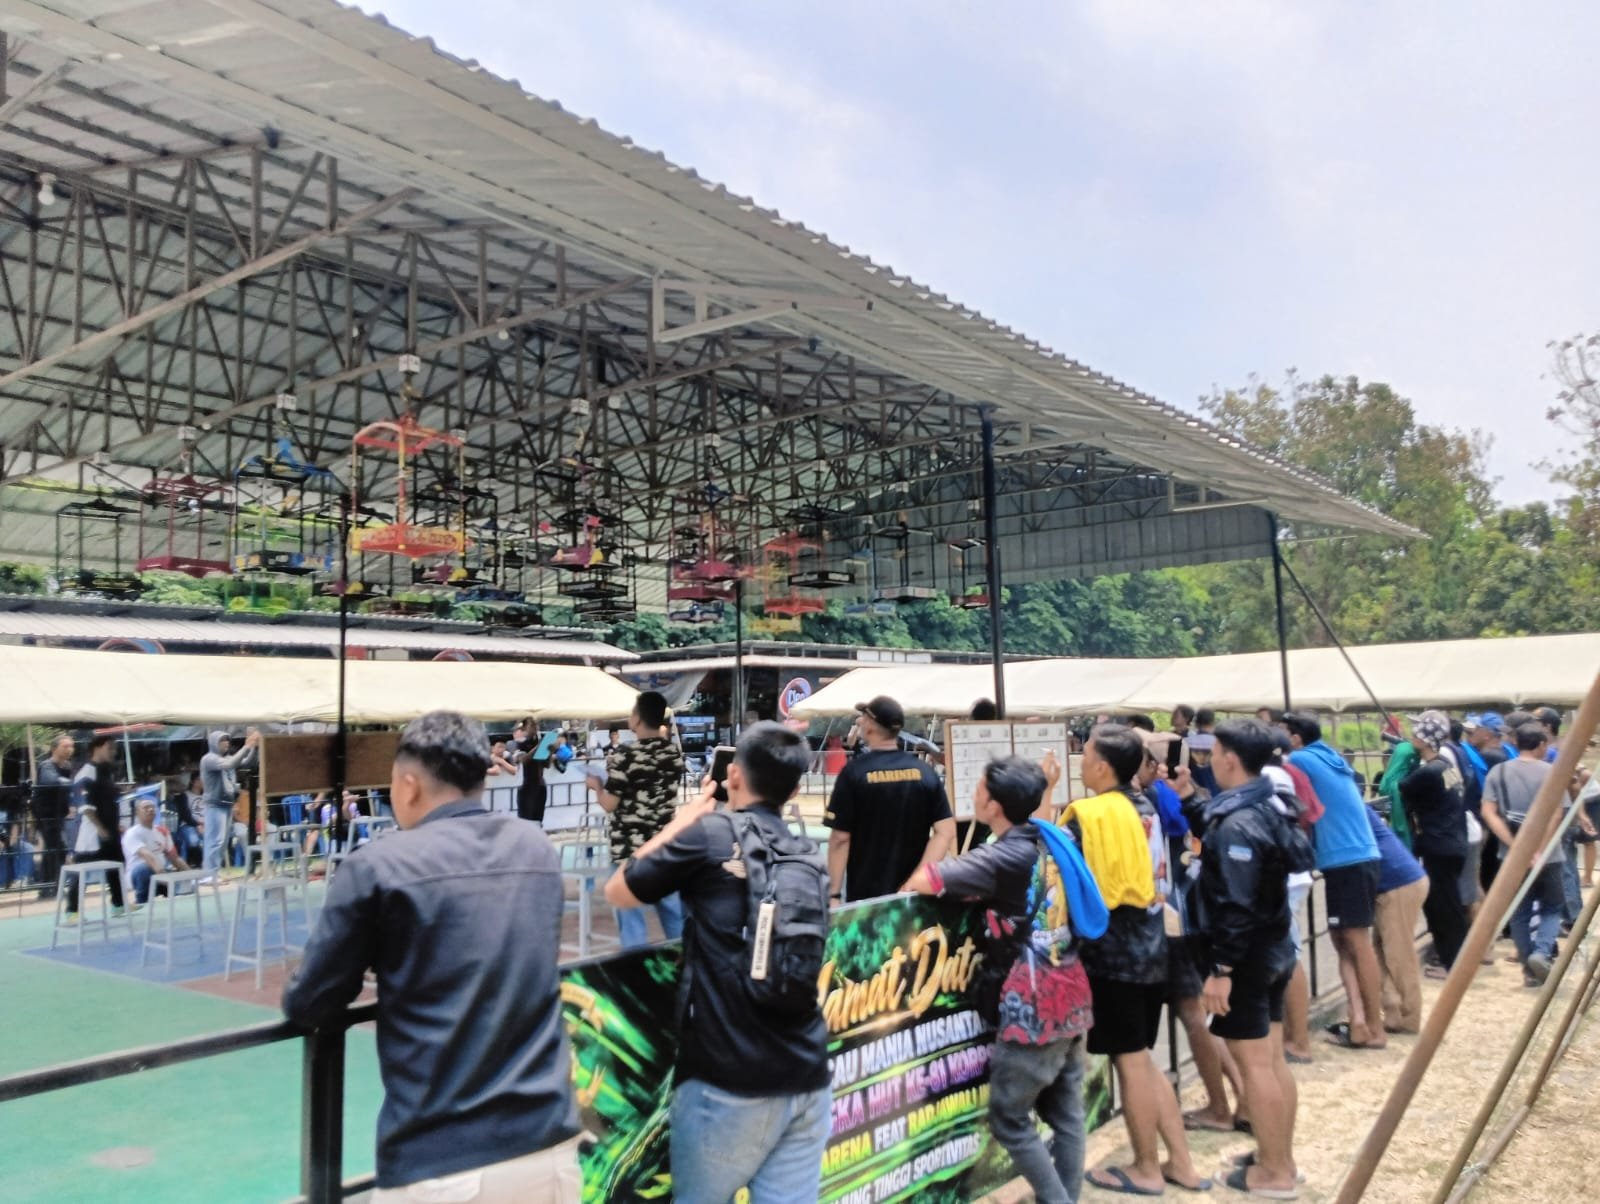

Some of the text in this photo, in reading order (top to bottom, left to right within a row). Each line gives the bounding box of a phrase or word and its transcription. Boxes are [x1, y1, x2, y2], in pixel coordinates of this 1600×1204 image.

[861, 1028, 914, 1077] MANIA
[868, 1076, 901, 1119] HUT
[821, 1131, 872, 1177] ARENA
[873, 1116, 906, 1153] FEAT
[874, 1162, 912, 1201] TINGGI
[913, 1132, 980, 1180] SPORTIVITAS
